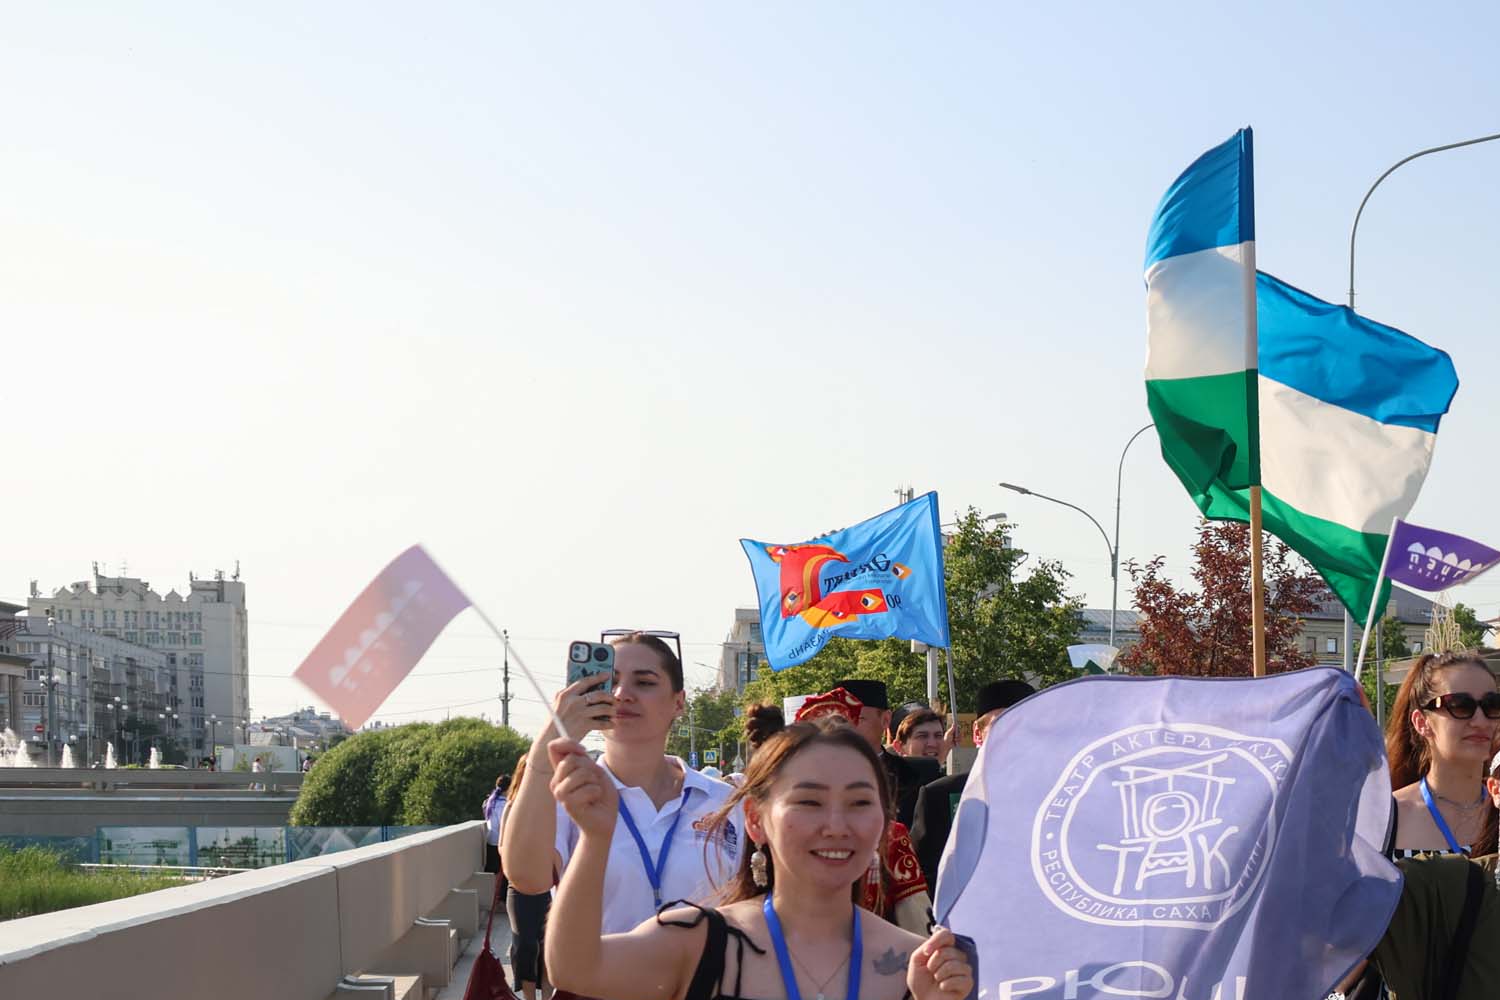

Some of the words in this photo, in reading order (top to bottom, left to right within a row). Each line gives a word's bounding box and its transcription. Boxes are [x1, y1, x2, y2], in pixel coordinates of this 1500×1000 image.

[1045, 755, 1095, 821] ТЕАТР
[1111, 731, 1212, 755] АКТЕРА
[1042, 849, 1138, 919] РЕСПУБЛИКА
[1152, 906, 1212, 919] САХА
